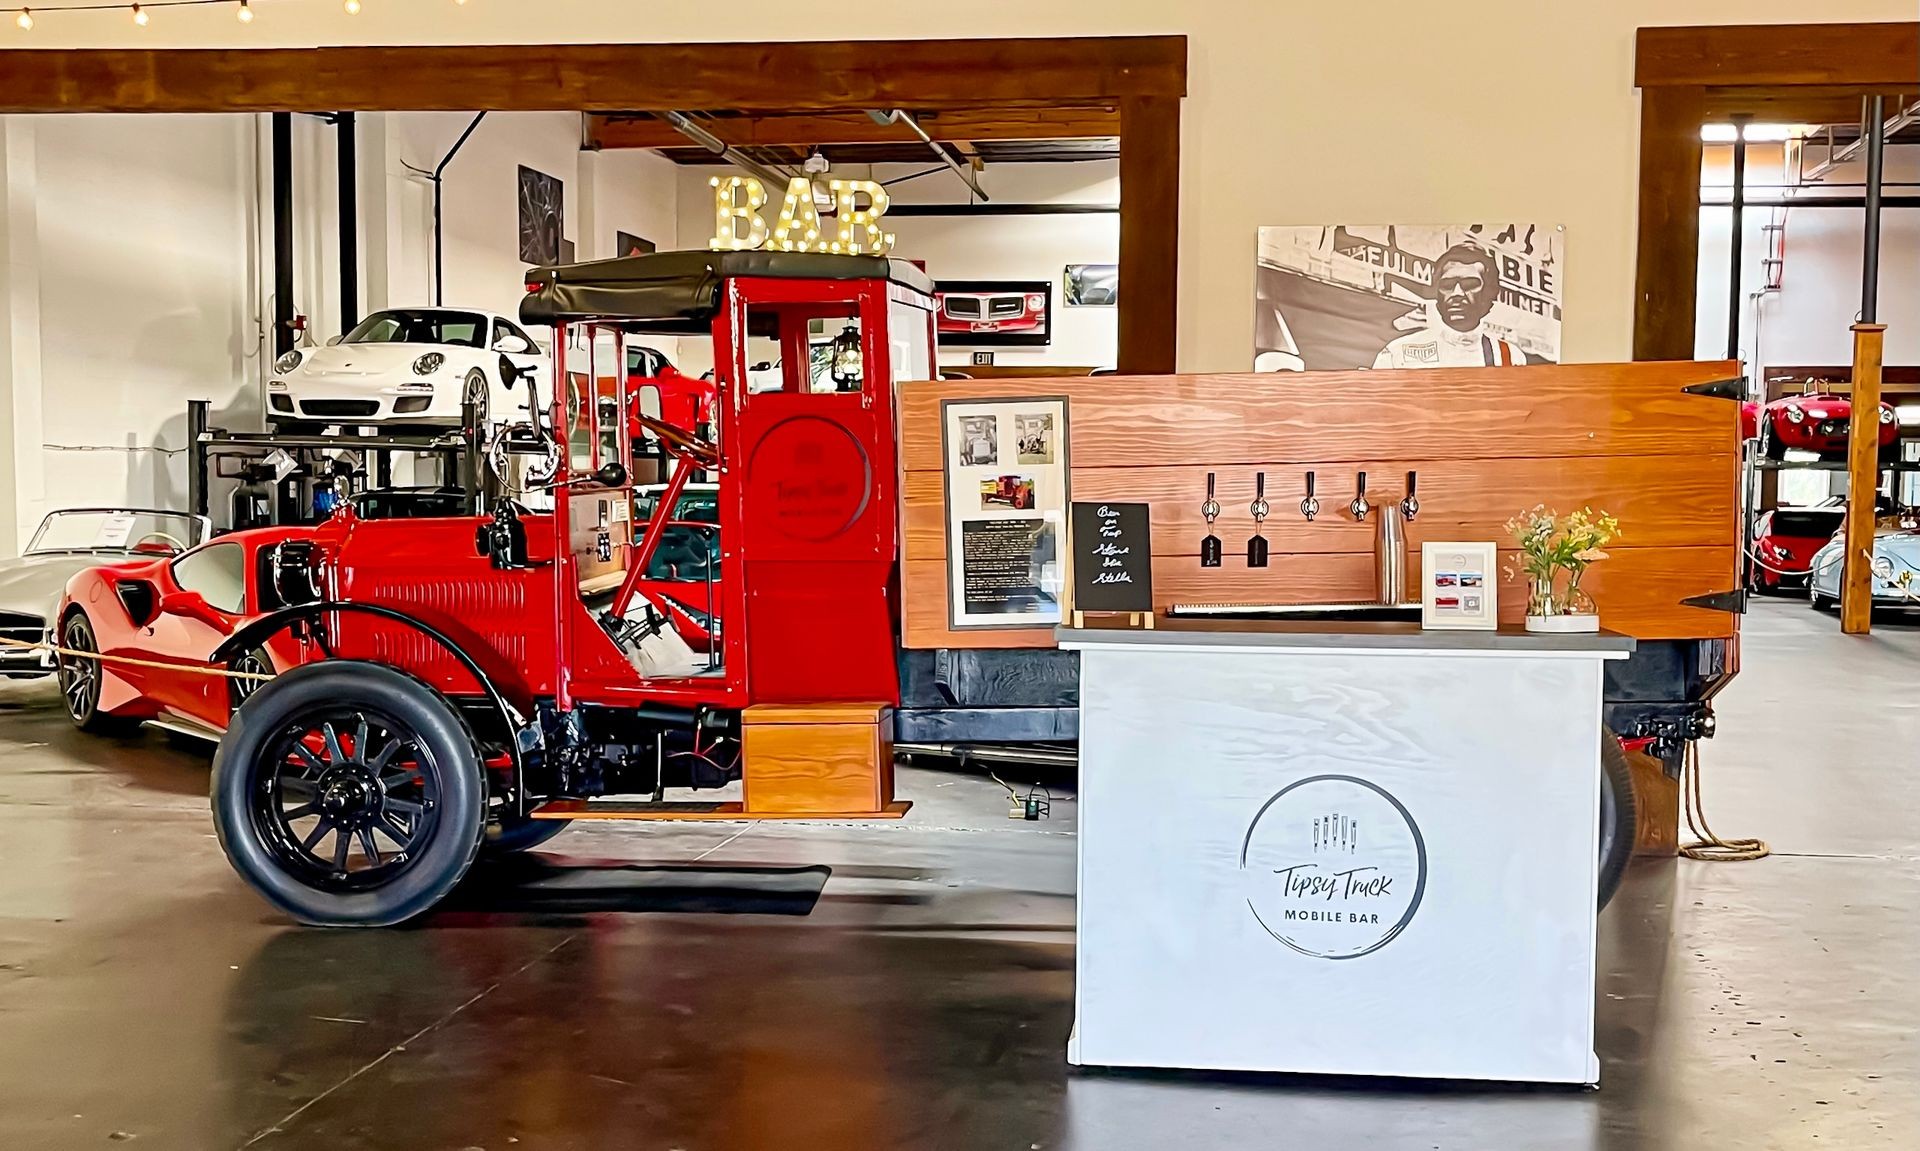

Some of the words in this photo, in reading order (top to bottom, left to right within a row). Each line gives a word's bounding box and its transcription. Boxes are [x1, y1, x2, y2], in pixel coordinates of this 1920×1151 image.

[709, 176, 892, 255] BAR
[976, 353, 992, 365] EXIT
[1273, 863, 1338, 900] Tipsy
[1333, 866, 1393, 900] Truck
[1284, 909, 1342, 923] MOBILE
[1349, 912, 1379, 924] BAR
